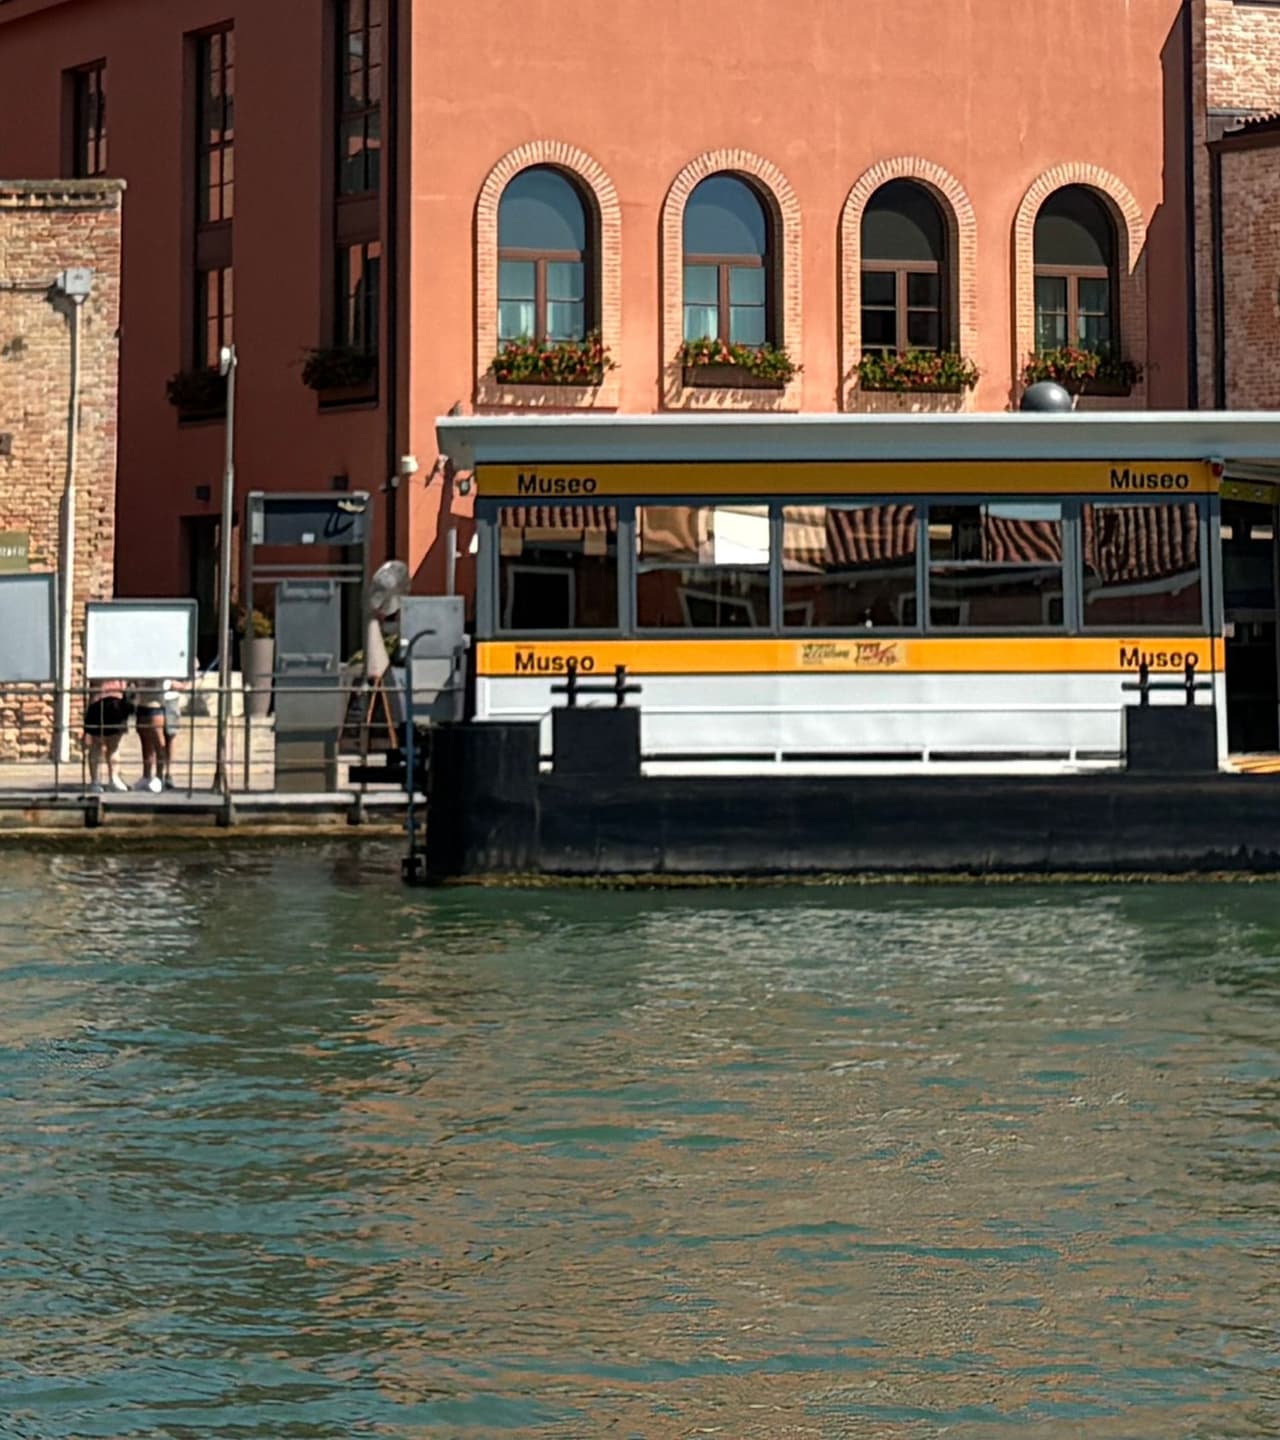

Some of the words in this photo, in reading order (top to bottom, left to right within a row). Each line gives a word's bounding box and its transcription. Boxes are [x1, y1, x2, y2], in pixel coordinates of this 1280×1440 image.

[517, 474, 597, 494] Museo
[1110, 469, 1189, 489] Museo
[515, 651, 595, 671] Museo
[1119, 647, 1199, 668] Museo
